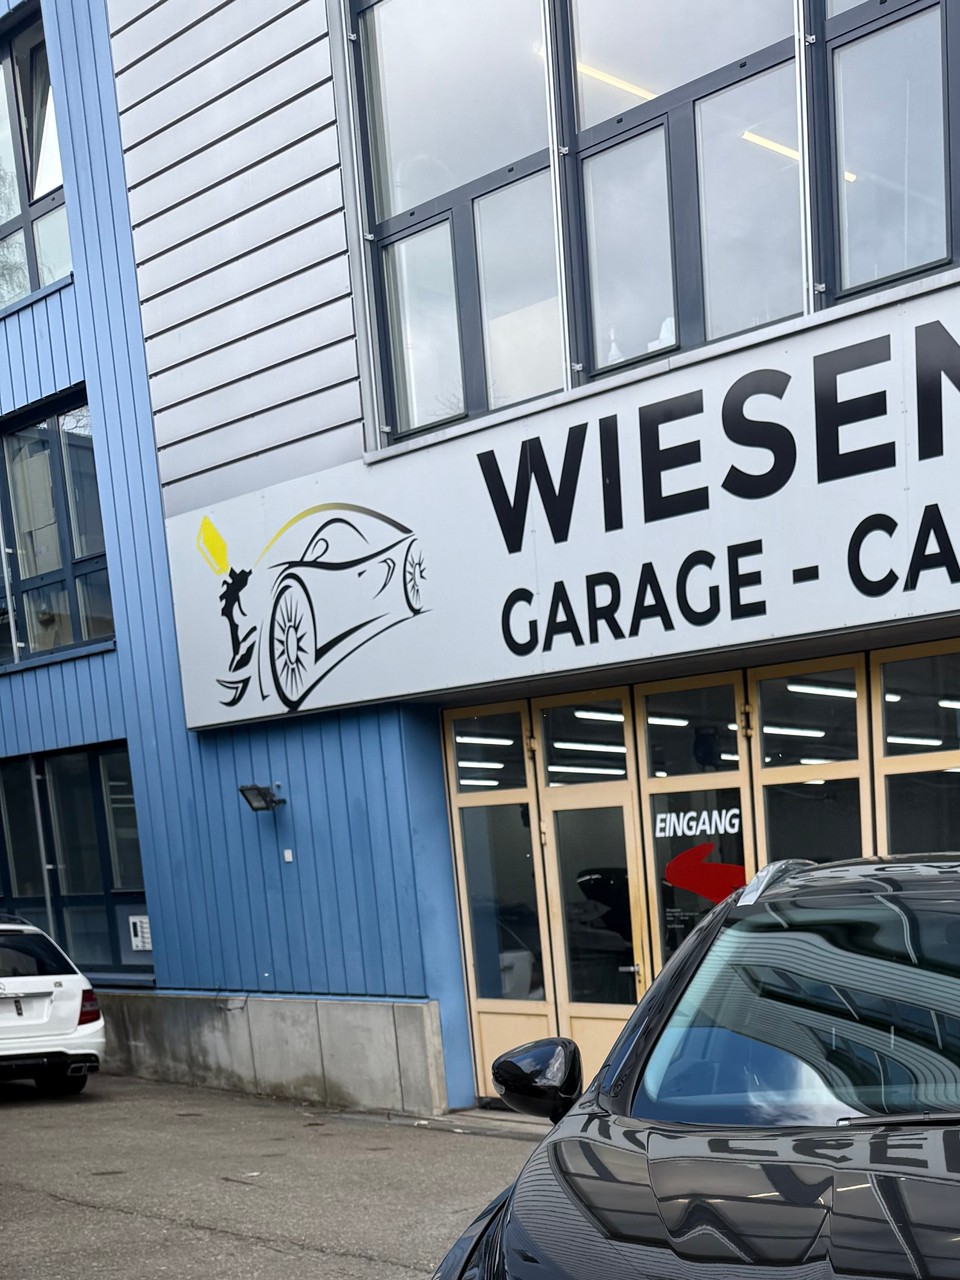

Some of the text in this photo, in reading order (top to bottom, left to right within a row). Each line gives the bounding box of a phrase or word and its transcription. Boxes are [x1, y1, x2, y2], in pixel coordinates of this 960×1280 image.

[500, 538, 767, 657] GARAGE
[792, 565, 819, 584] -
[655, 808, 740, 838] EINGANG
